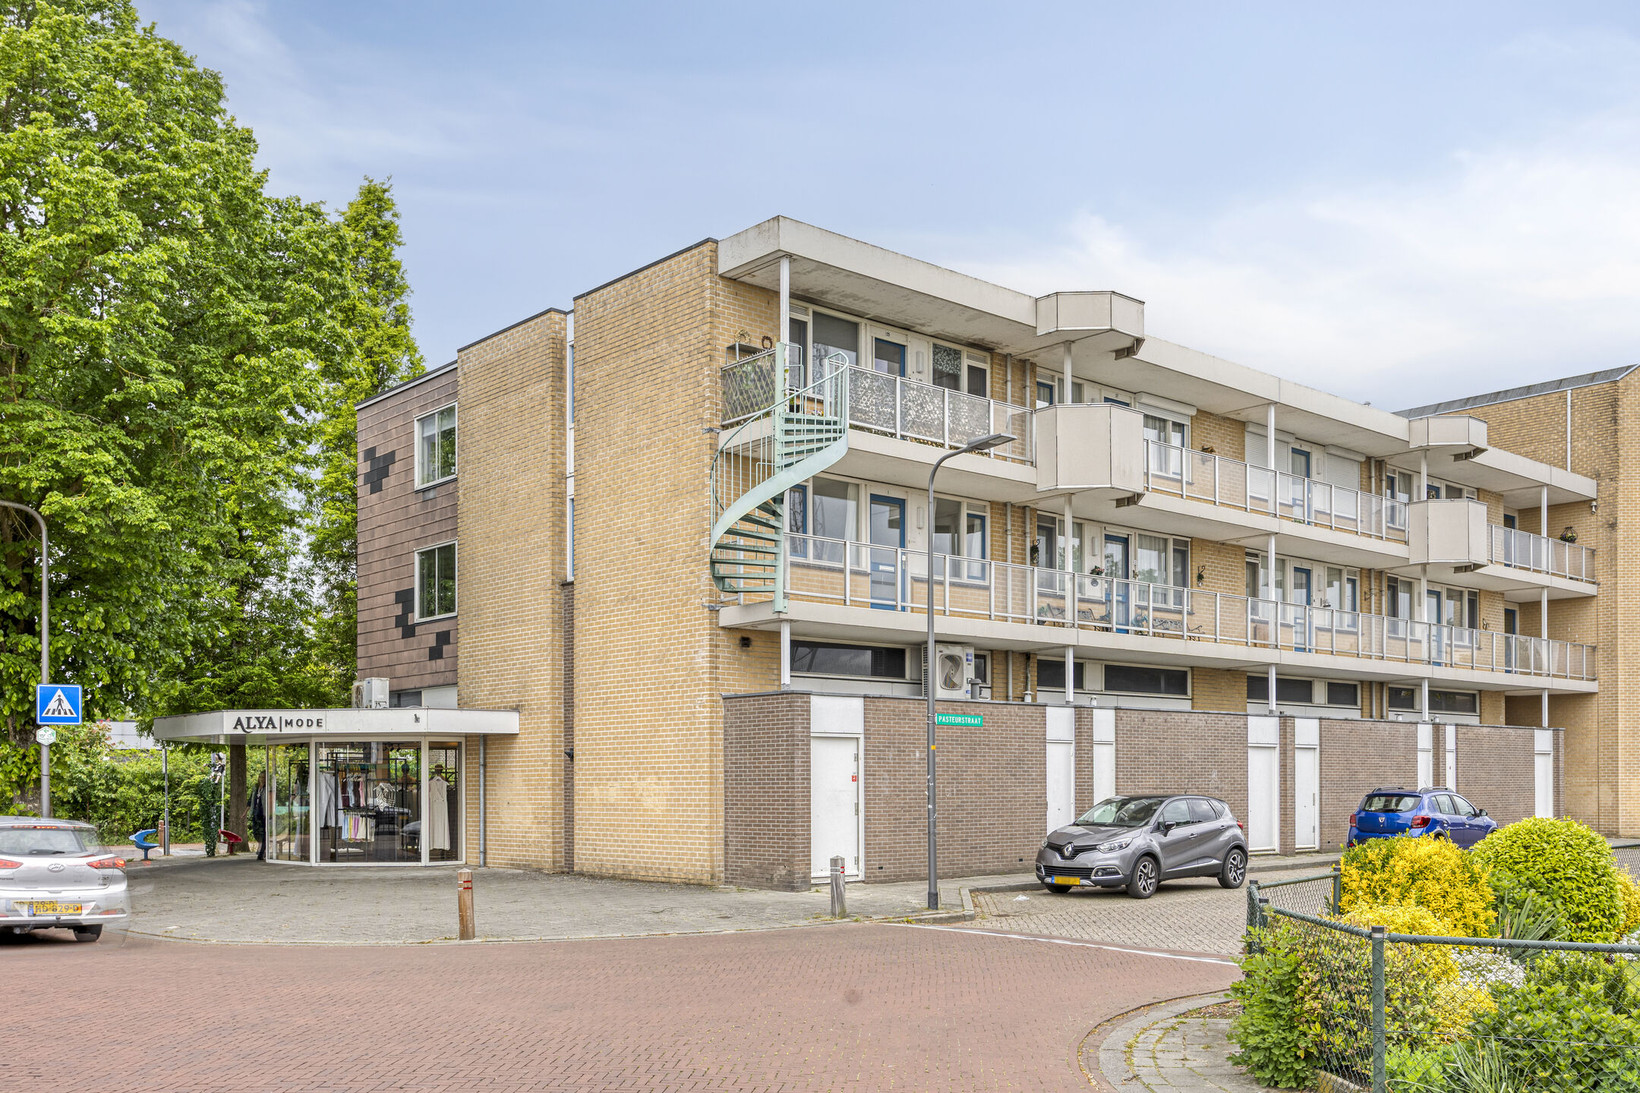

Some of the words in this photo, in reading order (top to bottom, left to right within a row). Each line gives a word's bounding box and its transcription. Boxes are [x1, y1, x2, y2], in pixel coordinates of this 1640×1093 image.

[232, 716, 278, 734] ALYA
[284, 718, 324, 728] MODE
[938, 715, 982, 725] PASTEURSTRAAT
